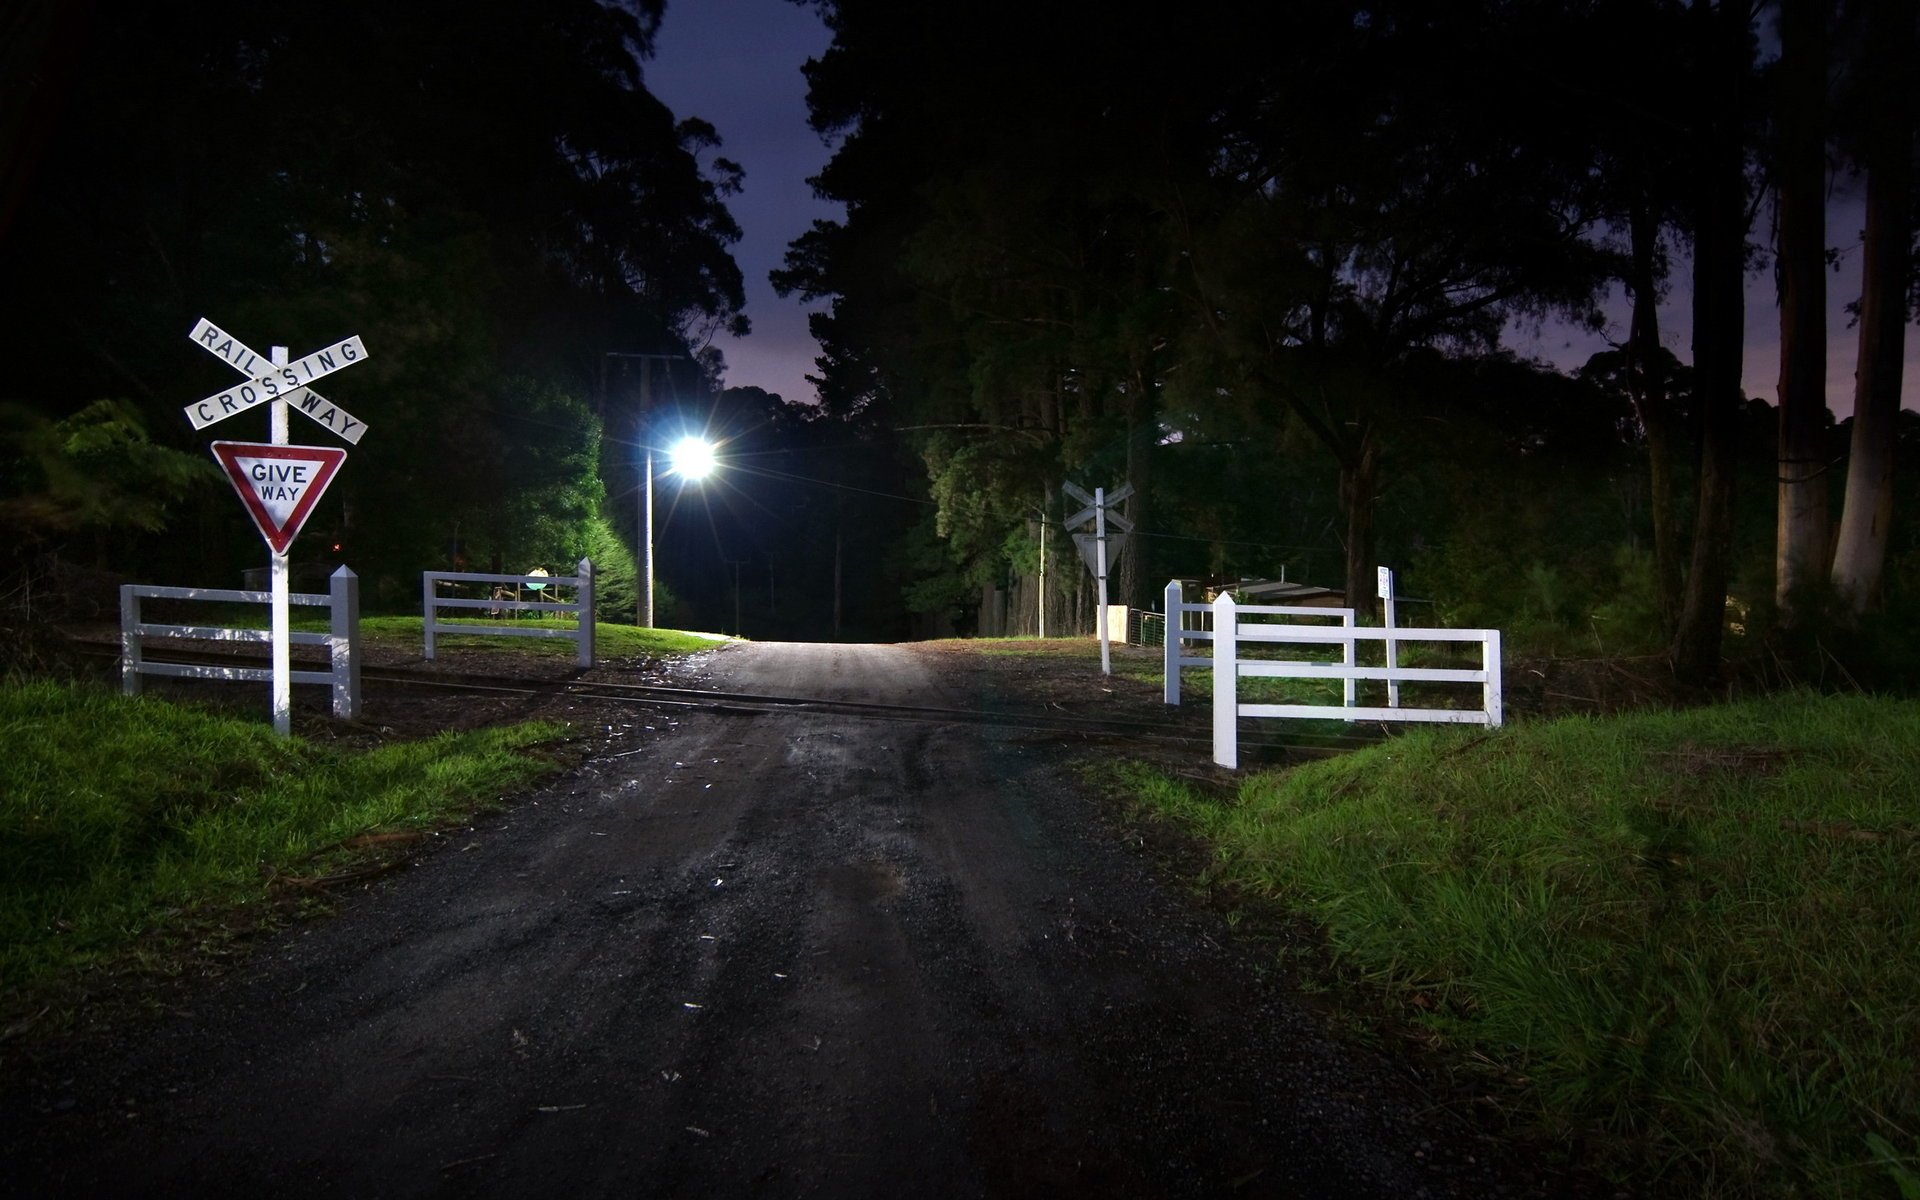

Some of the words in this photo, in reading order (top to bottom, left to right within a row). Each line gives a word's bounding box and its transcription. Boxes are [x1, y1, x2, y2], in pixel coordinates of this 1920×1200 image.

[198, 343, 357, 421] CROSSING
[200, 326, 254, 376] RAIL
[301, 392, 358, 435] WAY
[252, 464, 306, 483] GIVE
[261, 486, 299, 501] WAY
